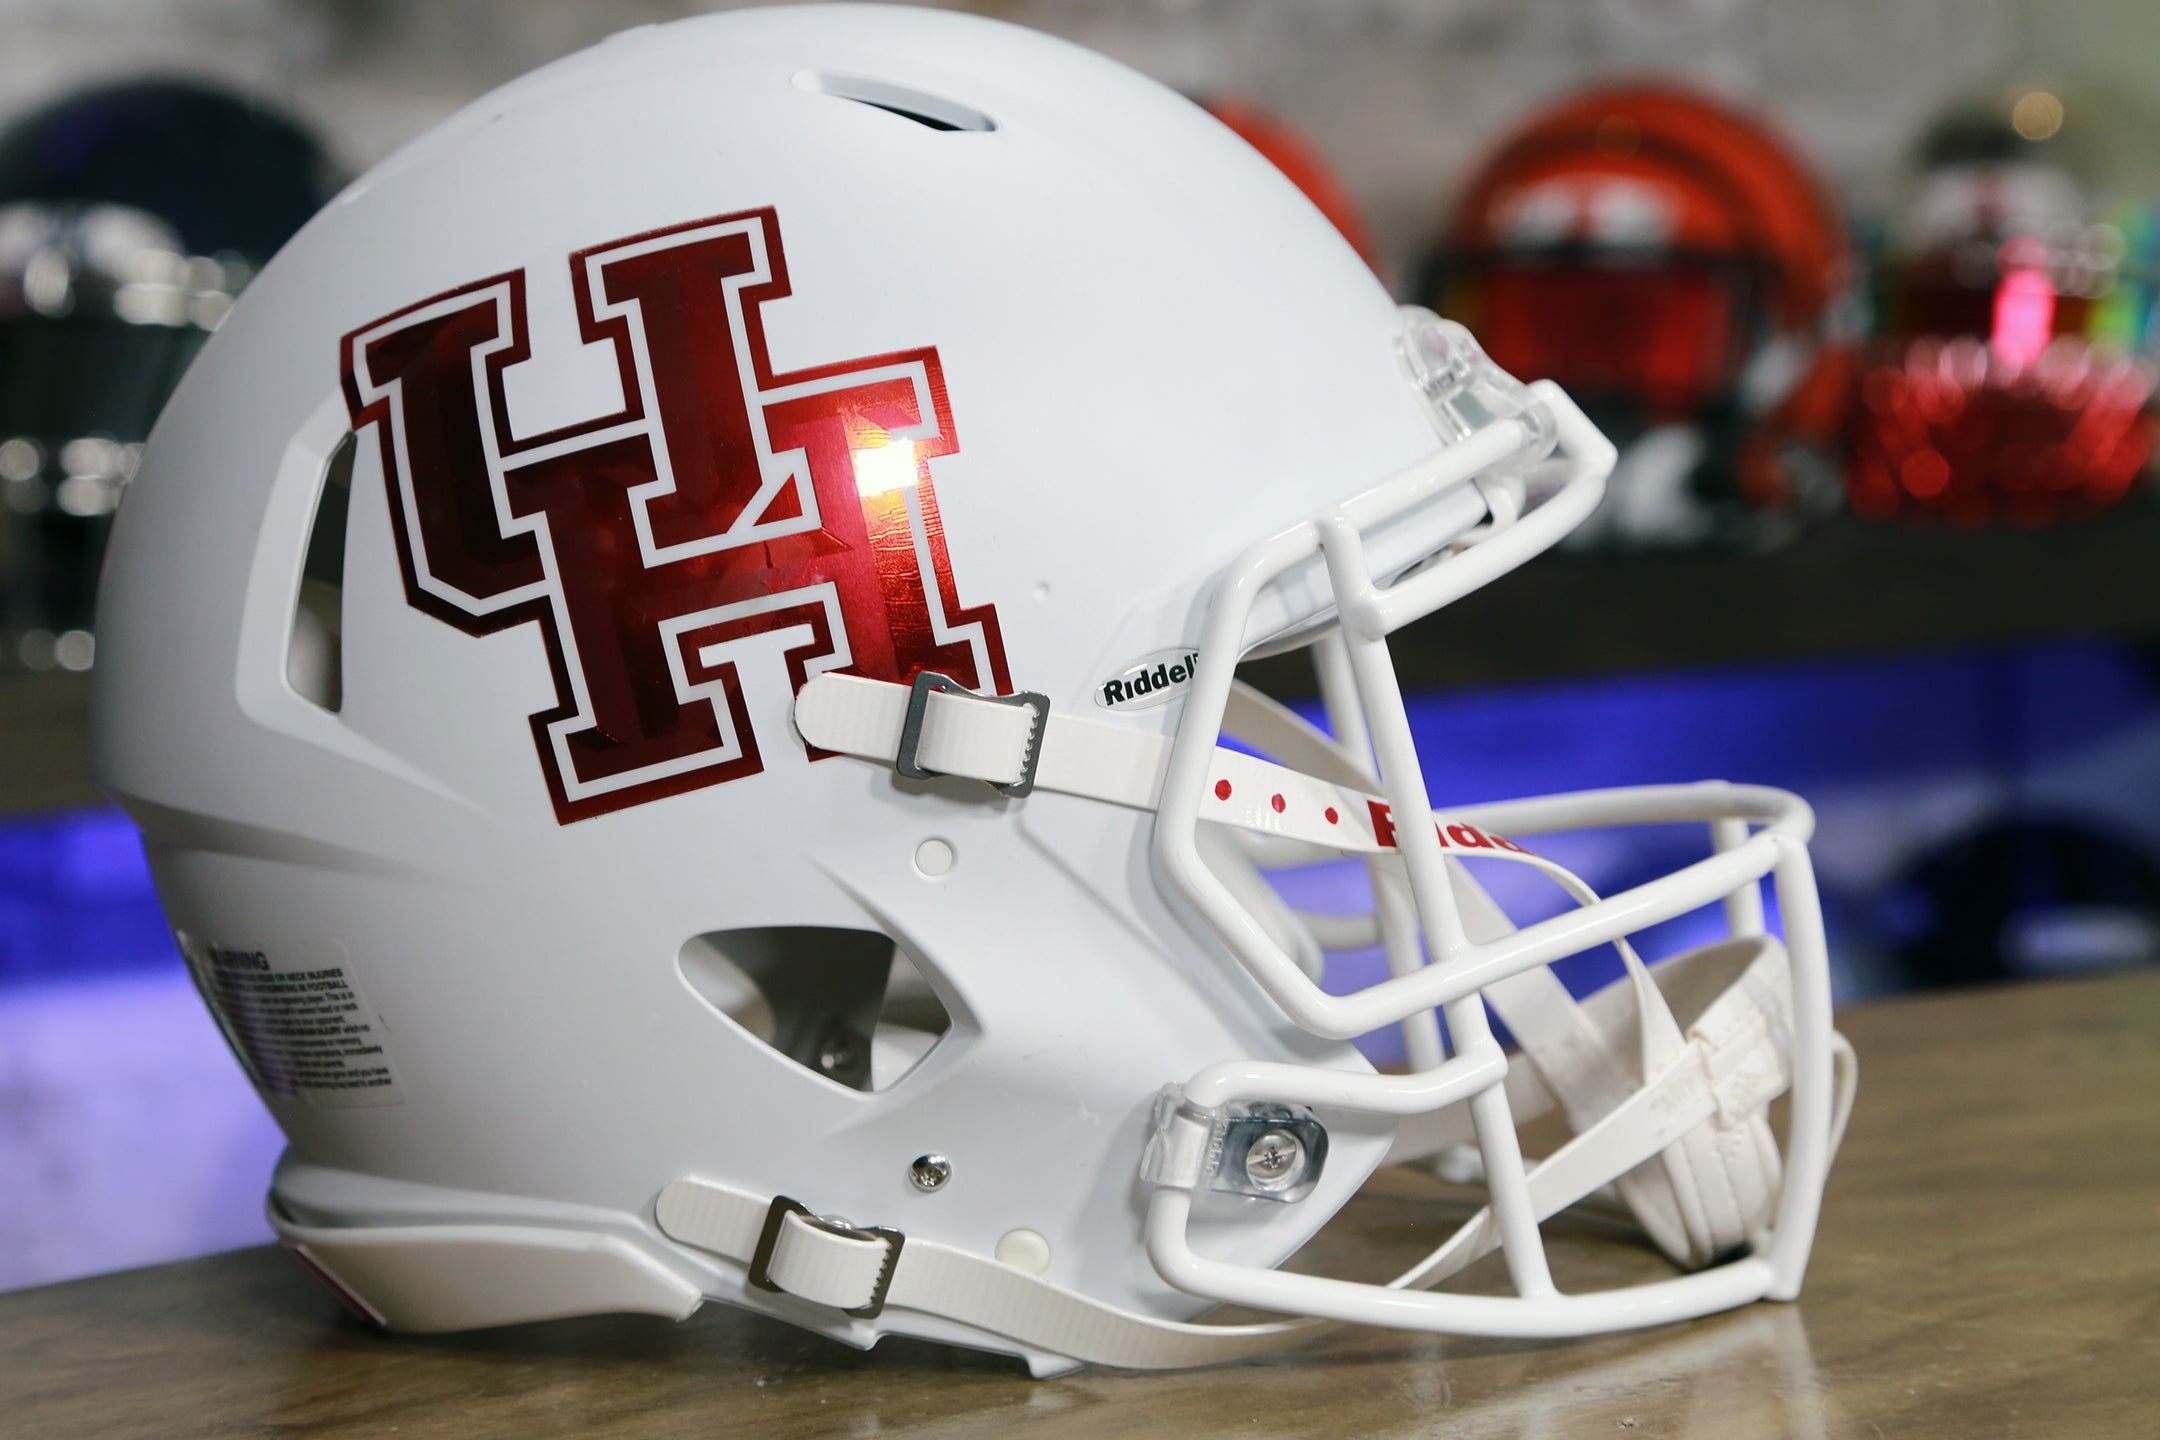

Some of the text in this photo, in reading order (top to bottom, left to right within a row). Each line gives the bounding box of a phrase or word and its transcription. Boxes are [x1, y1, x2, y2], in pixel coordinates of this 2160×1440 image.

[341, 205, 1013, 826] UH
[307, 968, 343, 979] INJURIES
[308, 980, 349, 992] FOOTBALL
